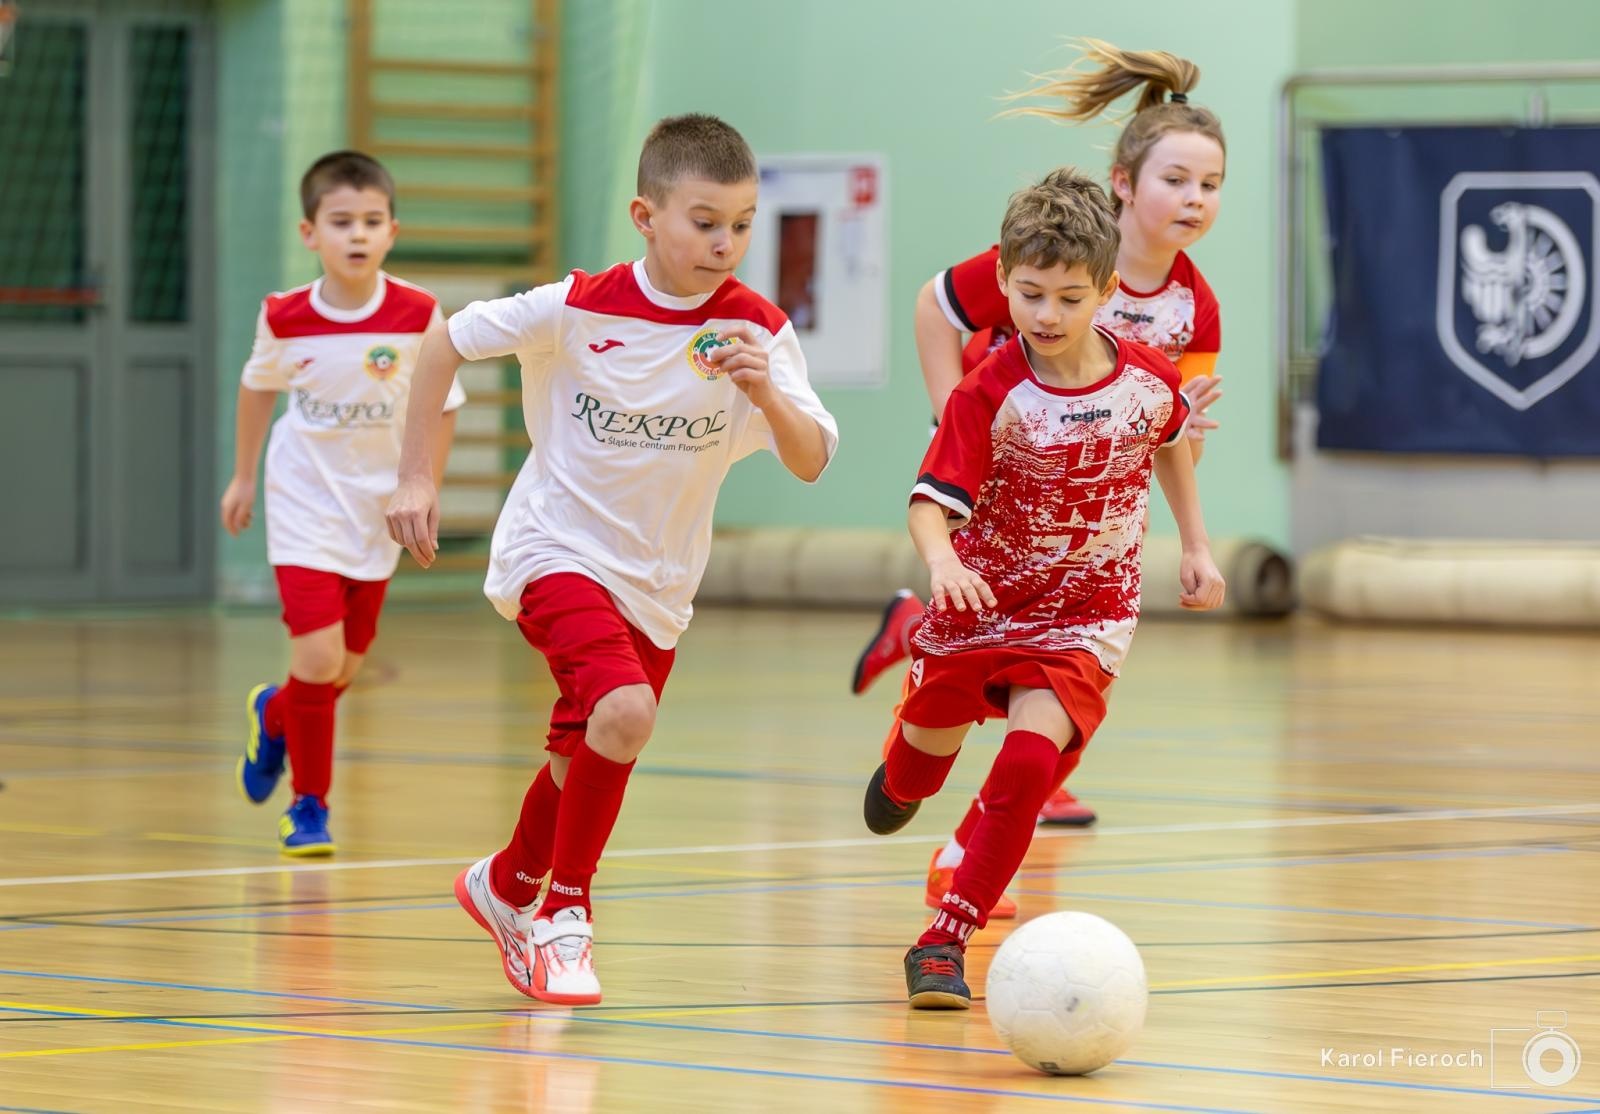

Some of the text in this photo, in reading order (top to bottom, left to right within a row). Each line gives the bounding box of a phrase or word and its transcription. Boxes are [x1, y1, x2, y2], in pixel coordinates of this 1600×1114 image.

[571, 392, 727, 442] REKPOL
[1060, 408, 1112, 424] regio
[640, 440, 676, 451] Centrum
[516, 870, 544, 885] Jom
[551, 880, 584, 896] Joma
